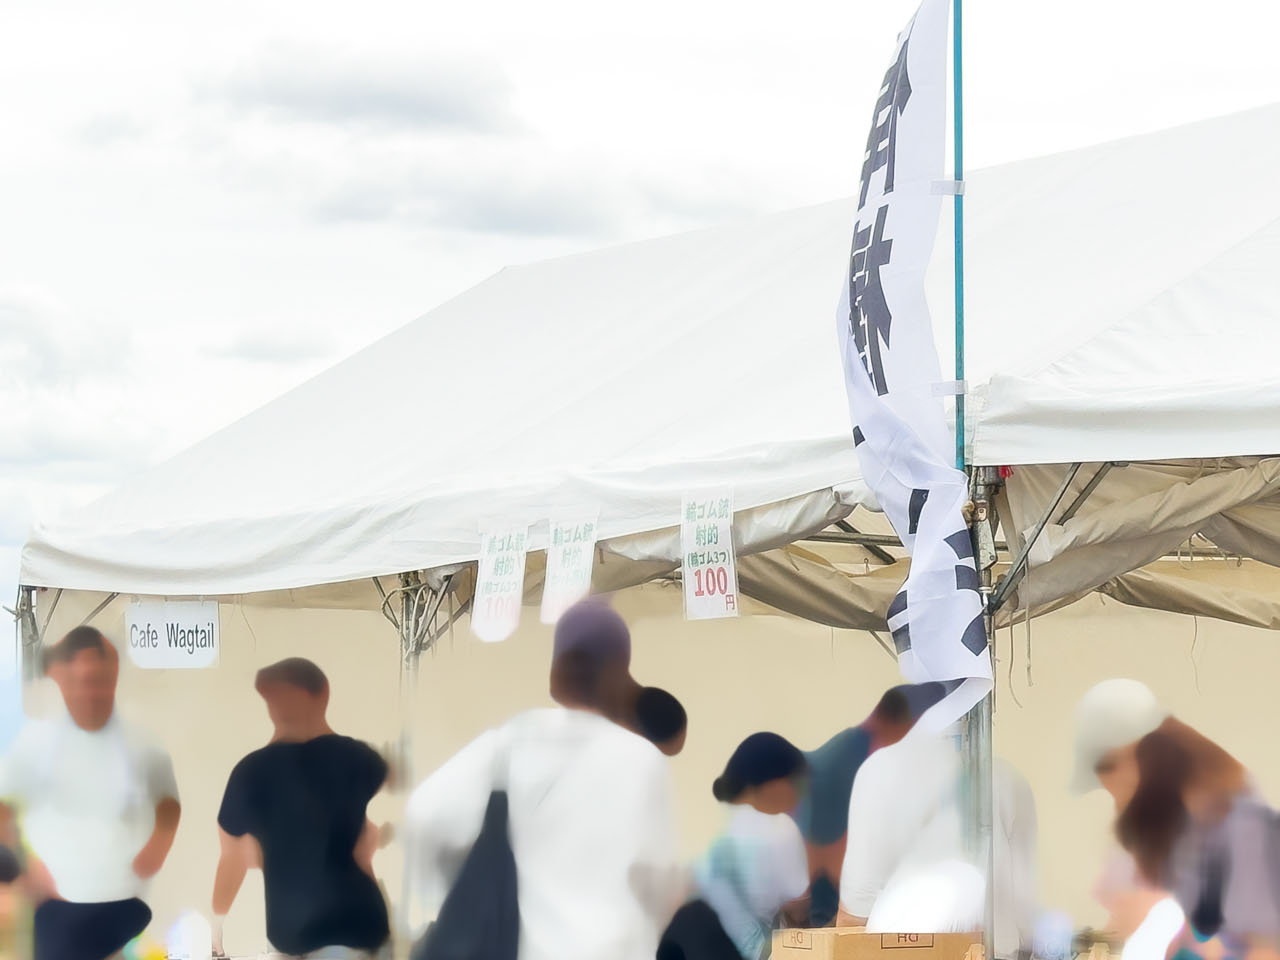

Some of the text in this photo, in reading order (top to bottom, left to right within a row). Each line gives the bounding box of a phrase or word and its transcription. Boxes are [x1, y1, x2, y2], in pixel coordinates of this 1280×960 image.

[695, 523, 719, 546] 射的
[130, 622, 214, 655] Cafe Wagtail
